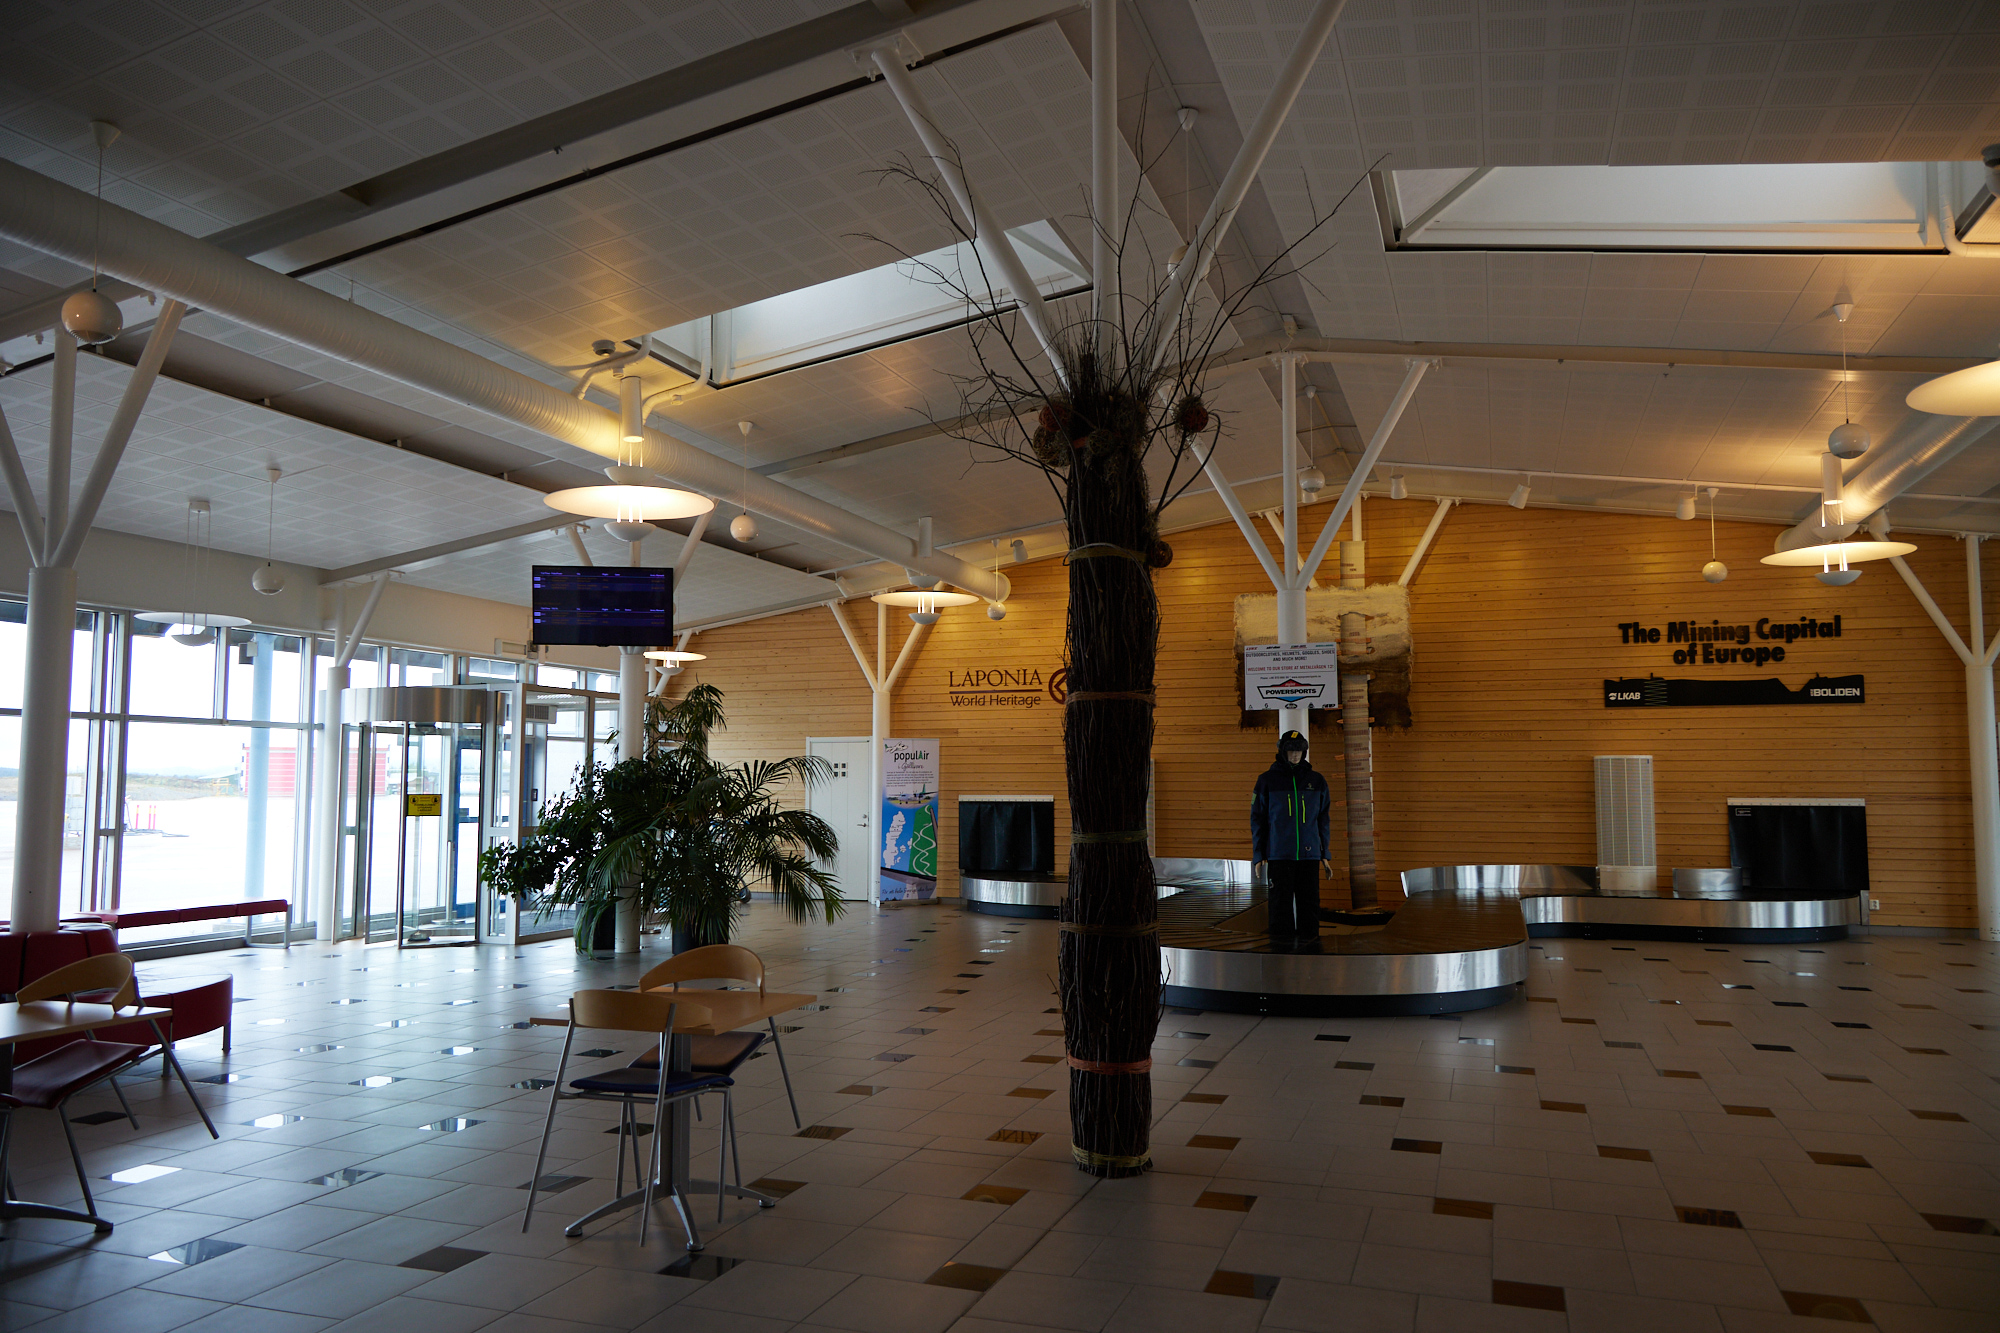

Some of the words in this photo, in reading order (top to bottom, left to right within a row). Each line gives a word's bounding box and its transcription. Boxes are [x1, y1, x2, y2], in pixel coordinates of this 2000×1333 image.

[1619, 622, 1660, 643] The
[1667, 620, 1750, 644] Mining
[1756, 615, 1841, 642] Capital
[1674, 643, 1697, 664] of
[1703, 643, 1785, 666] Europe
[949, 669, 1042, 687] LAPONIA
[1617, 692, 1641, 701] LKAB
[1814, 688, 1860, 696] BOLIDEN
[950, 694, 985, 706] World
[990, 694, 1041, 708] Heritage
[894, 750, 930, 762] populAir
